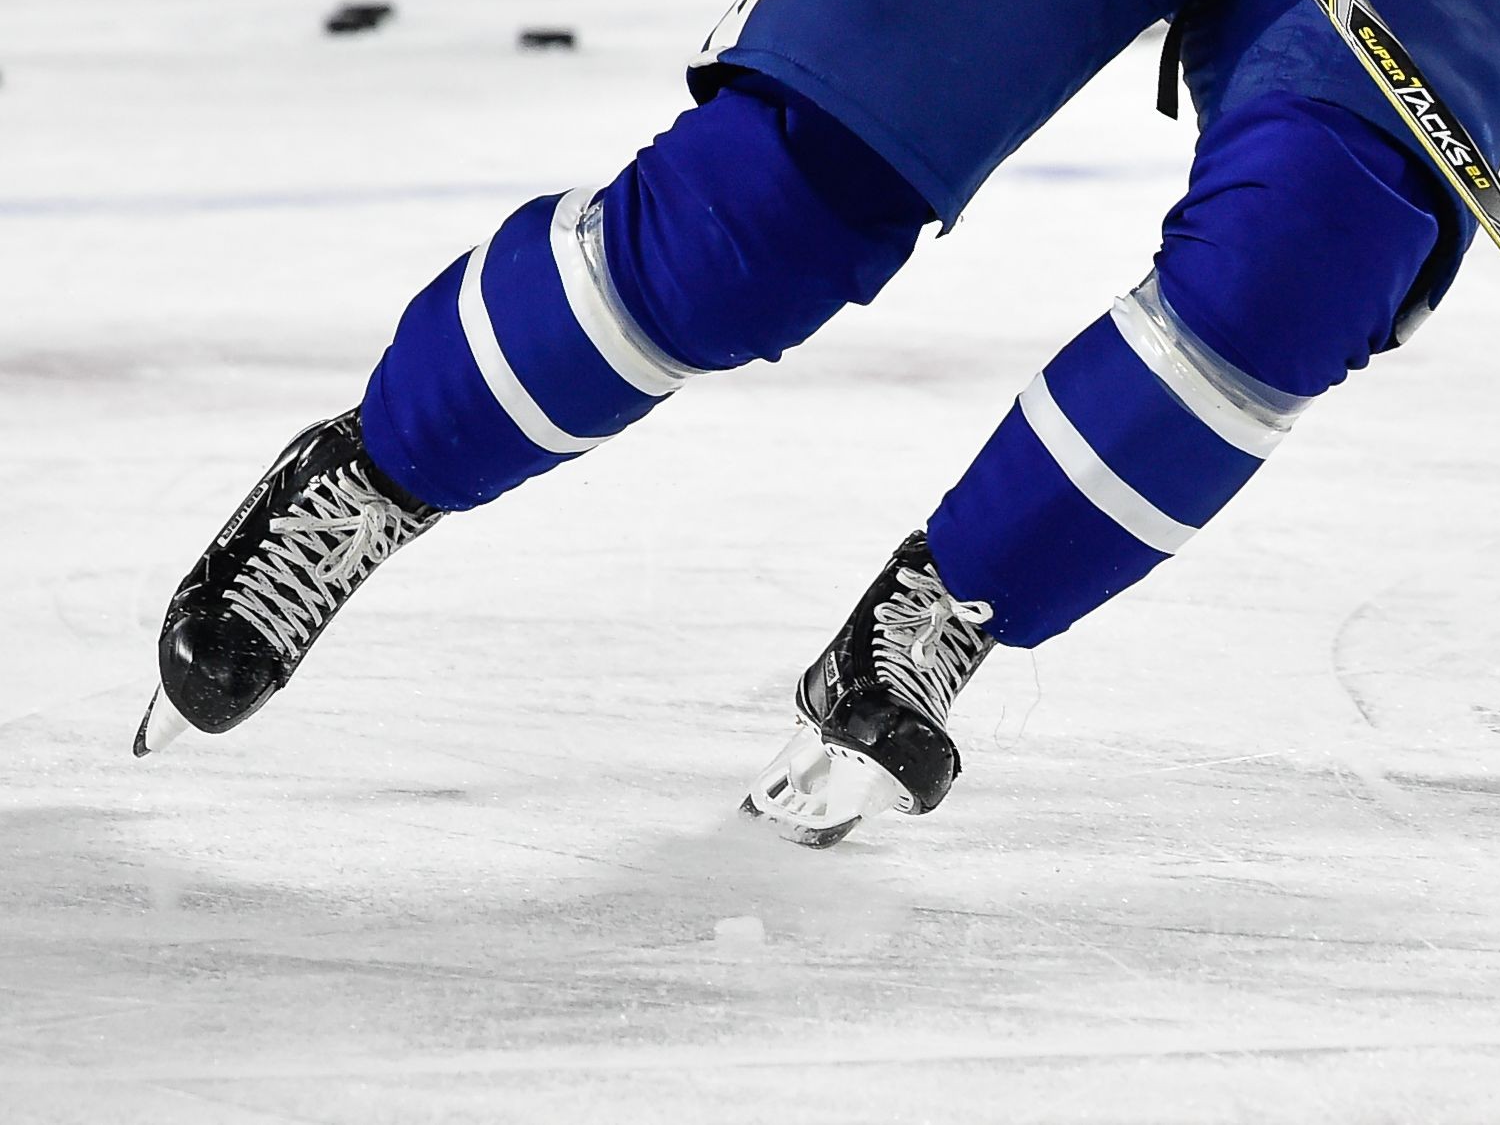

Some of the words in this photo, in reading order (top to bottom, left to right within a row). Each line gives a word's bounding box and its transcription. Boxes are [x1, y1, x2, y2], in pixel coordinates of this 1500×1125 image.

[1358, 26, 1406, 81] SUPER
[1393, 77, 1472, 166] TACKS
[1464, 165, 1491, 189] 2.0
